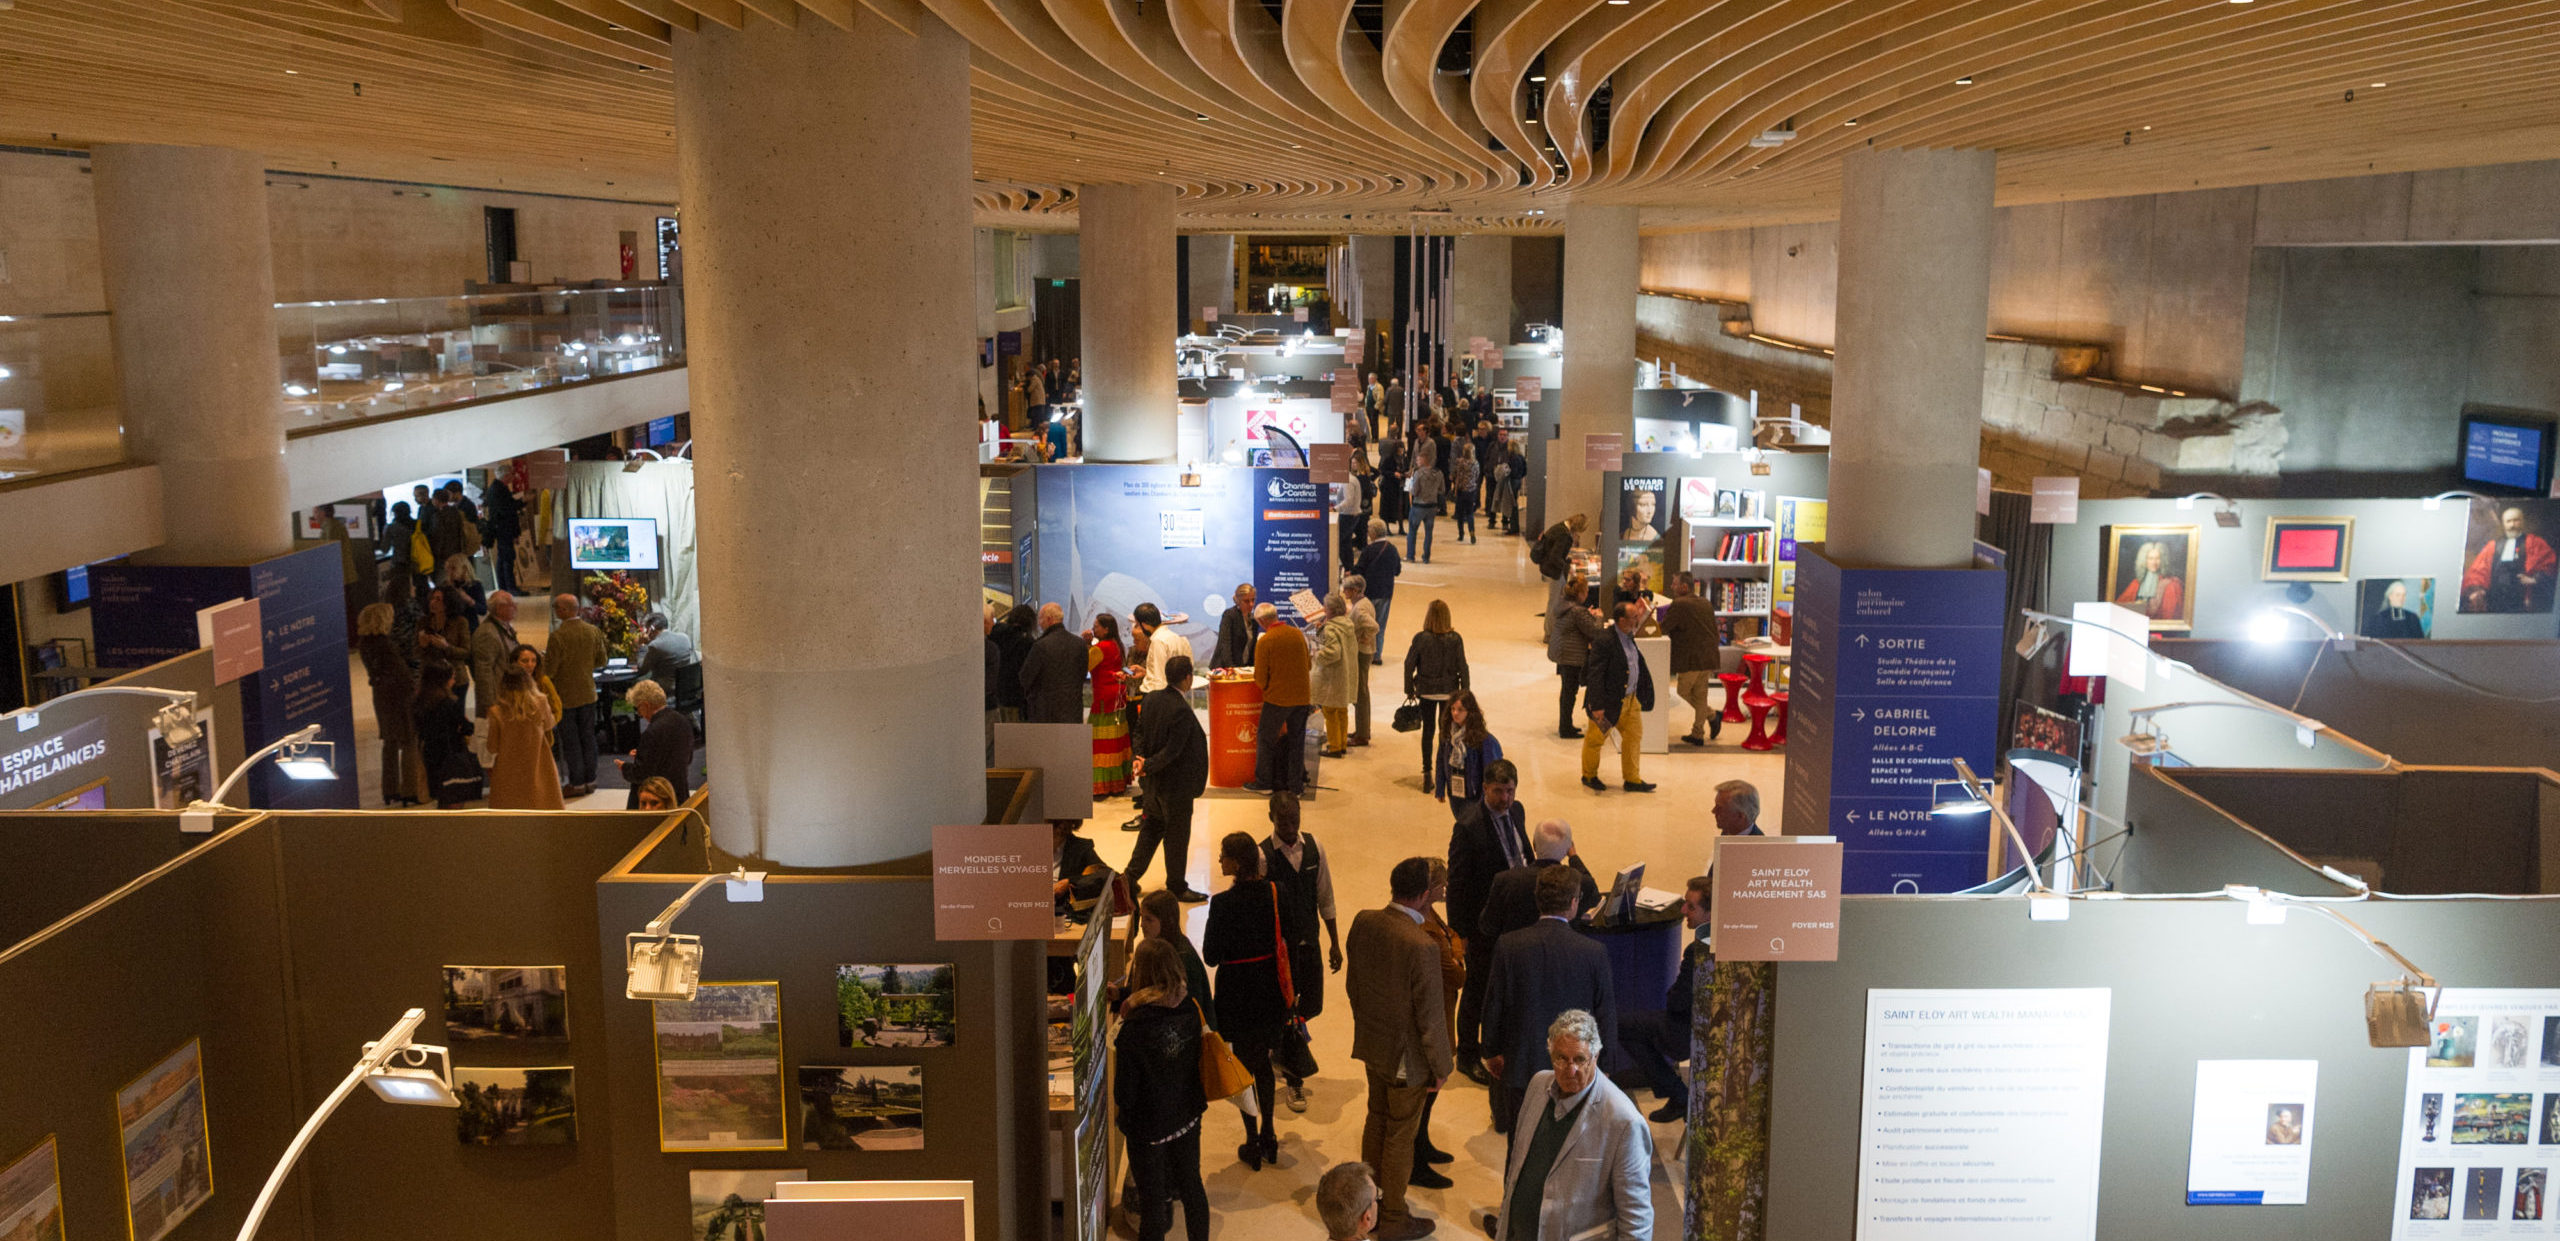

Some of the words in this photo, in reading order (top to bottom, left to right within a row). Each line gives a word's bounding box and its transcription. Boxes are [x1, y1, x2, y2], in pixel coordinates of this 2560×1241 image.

[1282, 481, 1316, 490] Chantiers
[1624, 477, 1663, 486] LÉONARD
[1857, 598, 1905, 608] patrimoine
[1878, 639, 1926, 649] SORTIE
[1913, 668, 1950, 677] Française
[1876, 678, 1895, 686] Salle
[1897, 678, 1907, 686] de
[1909, 678, 1952, 687] conférence
[1874, 709, 1930, 720] GABRIEL
[1874, 726, 1936, 736] DELORME
[1, 735, 64, 773] ESPACE
[0, 740, 106, 794] HÂTELAIN(E)S
[1869, 811, 1884, 820] LE
[1889, 809, 1932, 820] NÔTRE
[964, 855, 1006, 863] MONDES
[1009, 855, 1021, 863] ET
[939, 866, 999, 874] MERVEILLES
[1002, 865, 1048, 873] VOYAGES
[1752, 869, 1781, 877] SAINT
[1784, 869, 1810, 877] ELOY
[1747, 880, 1768, 888] ART
[1771, 880, 1813, 888] WEALTH
[1732, 890, 1804, 899] MANAGEMENT
[1807, 890, 1827, 898] SAS
[1884, 1010, 1915, 1020] SAINT
[1919, 1010, 1945, 1020] ELOY
[1949, 1010, 1968, 1019] ART
[1972, 1010, 2014, 1019] WEALTH
